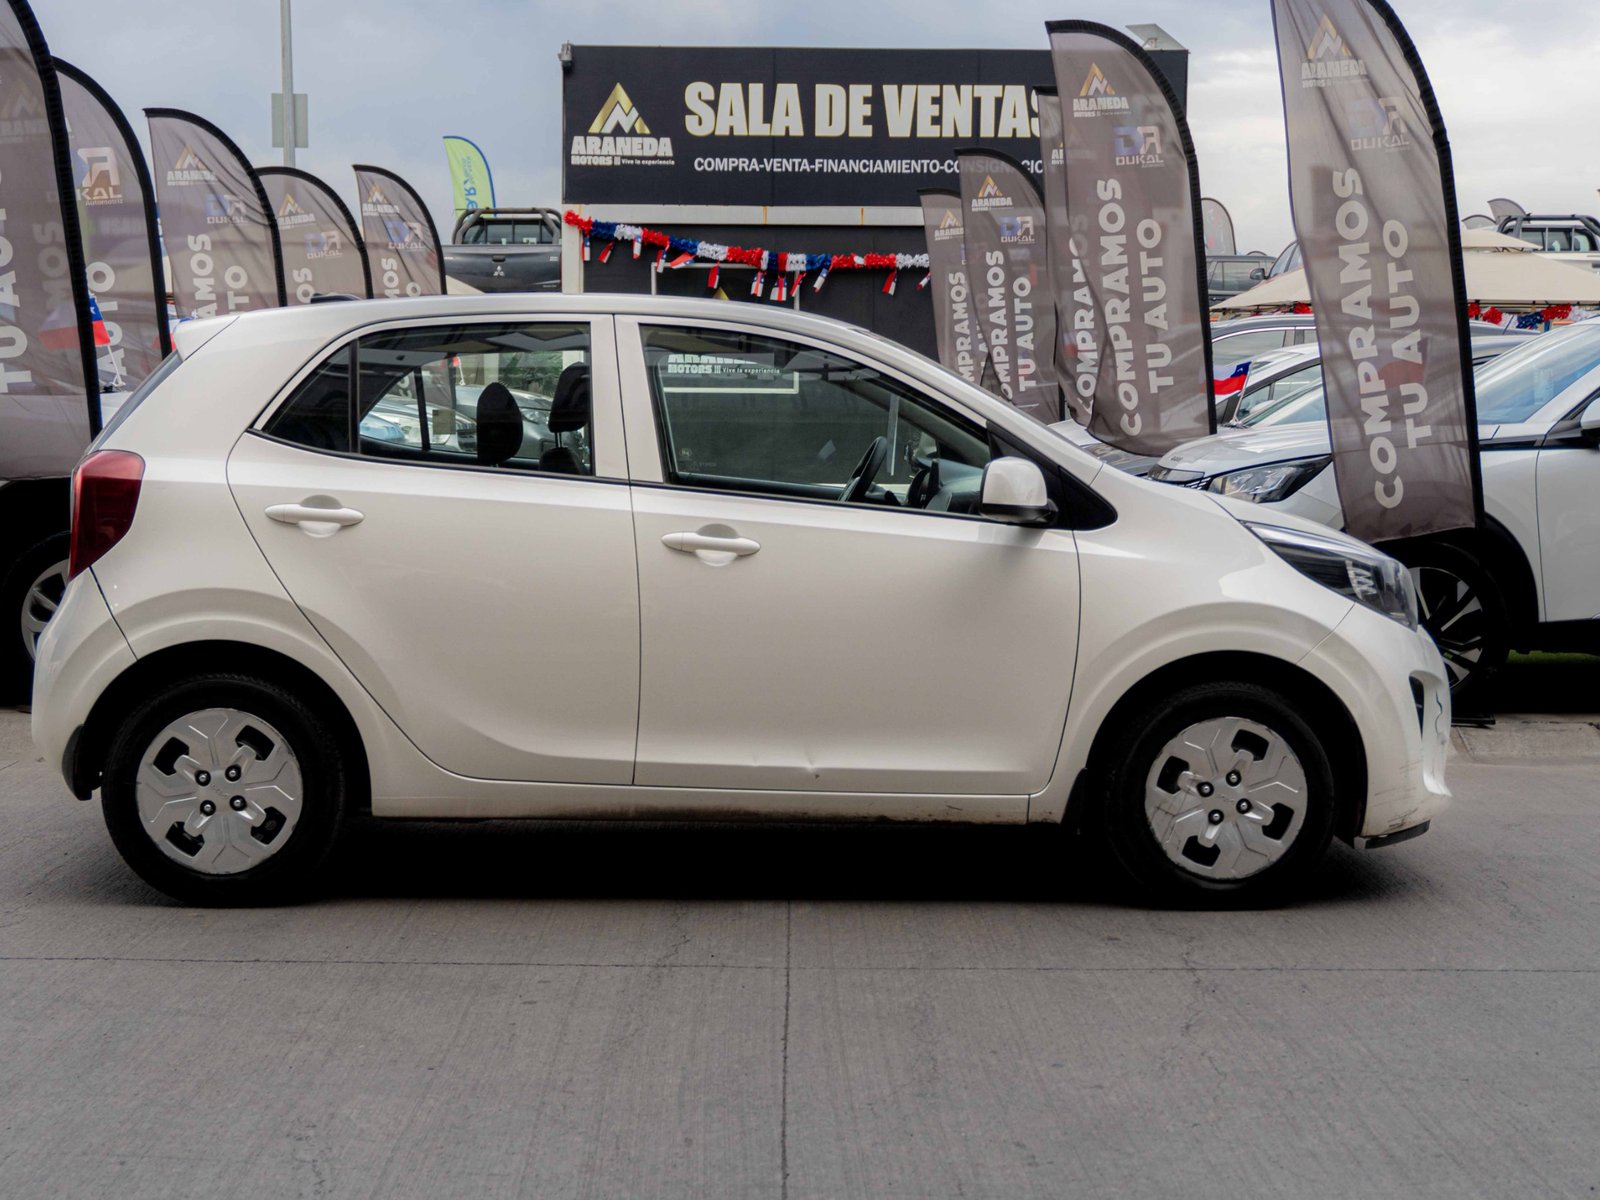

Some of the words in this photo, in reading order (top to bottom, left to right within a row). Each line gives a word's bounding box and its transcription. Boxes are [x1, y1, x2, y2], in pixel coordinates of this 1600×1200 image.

[684, 81, 804, 137] SALA
[814, 83, 873, 137] DE
[1072, 96, 1130, 112] ARANEDA
[571, 135, 673, 157] ARANEDA
[571, 155, 613, 166] MOTORS
[1115, 154, 1165, 167] DUKAL
[74, 187, 123, 201] KAL
[971, 196, 1014, 208] ARANEDA
[934, 227, 964, 238] ARANE
[1000, 235, 1036, 244] DUKAL
[1136, 218, 1169, 332] AUTO
[1382, 218, 1423, 365] AUTO
[948, 271, 975, 382] MPRAMOS
[985, 250, 1013, 399] OMPRAMOS
[1012, 276, 1034, 351] AUTO
[1096, 178, 1143, 437] COMPRAMOS
[1331, 167, 1405, 510] COMPRAMOS
[667, 364, 713, 374] MOTORS
[1018, 358, 1037, 392] TU
[1145, 342, 1175, 395] TU
[1399, 382, 1433, 450] TU
